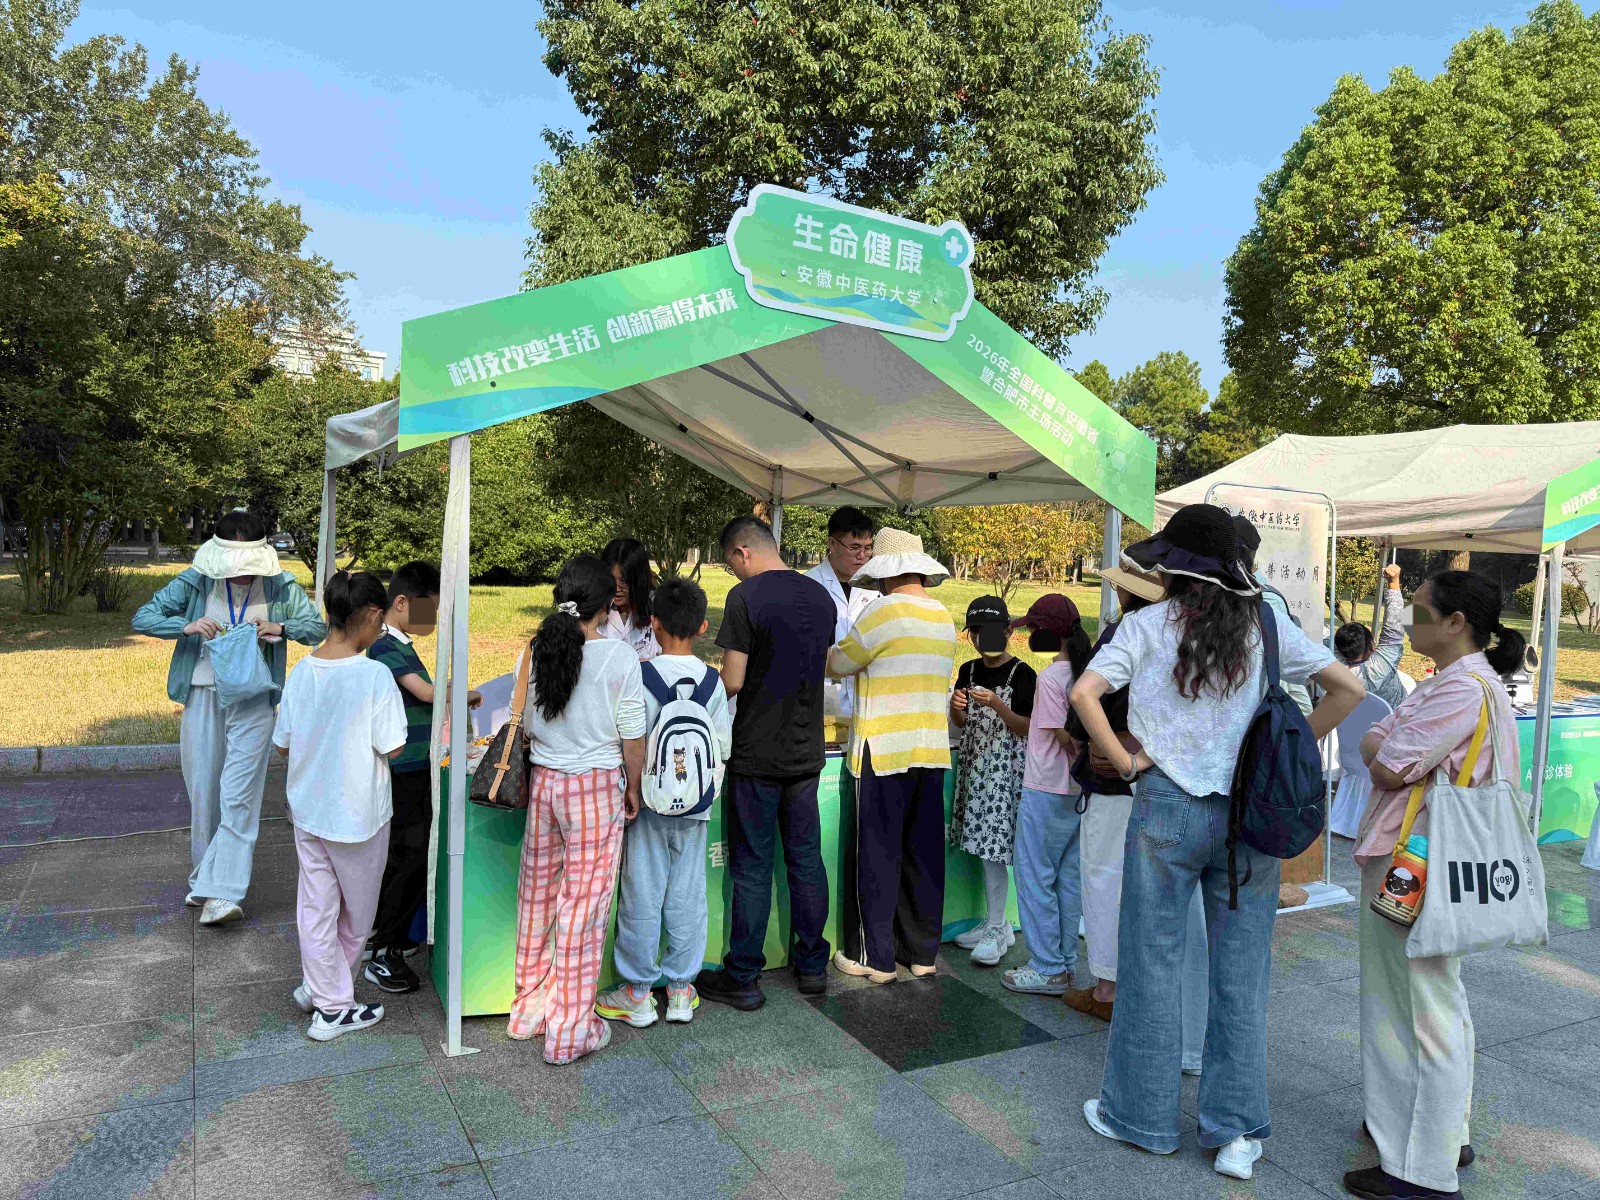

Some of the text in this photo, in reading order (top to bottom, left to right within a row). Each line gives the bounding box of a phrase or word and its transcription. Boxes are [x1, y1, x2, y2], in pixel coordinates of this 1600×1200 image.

[792, 213, 924, 276] 生命健康
[797, 264, 922, 307] 安徽中医药大学
[446, 287, 739, 388] 科技改变生活 创新赢得未来
[966, 333, 1100, 445] 2026年全国科普月安徽省
[978, 365, 1074, 447] 暨合肥市主场活动
